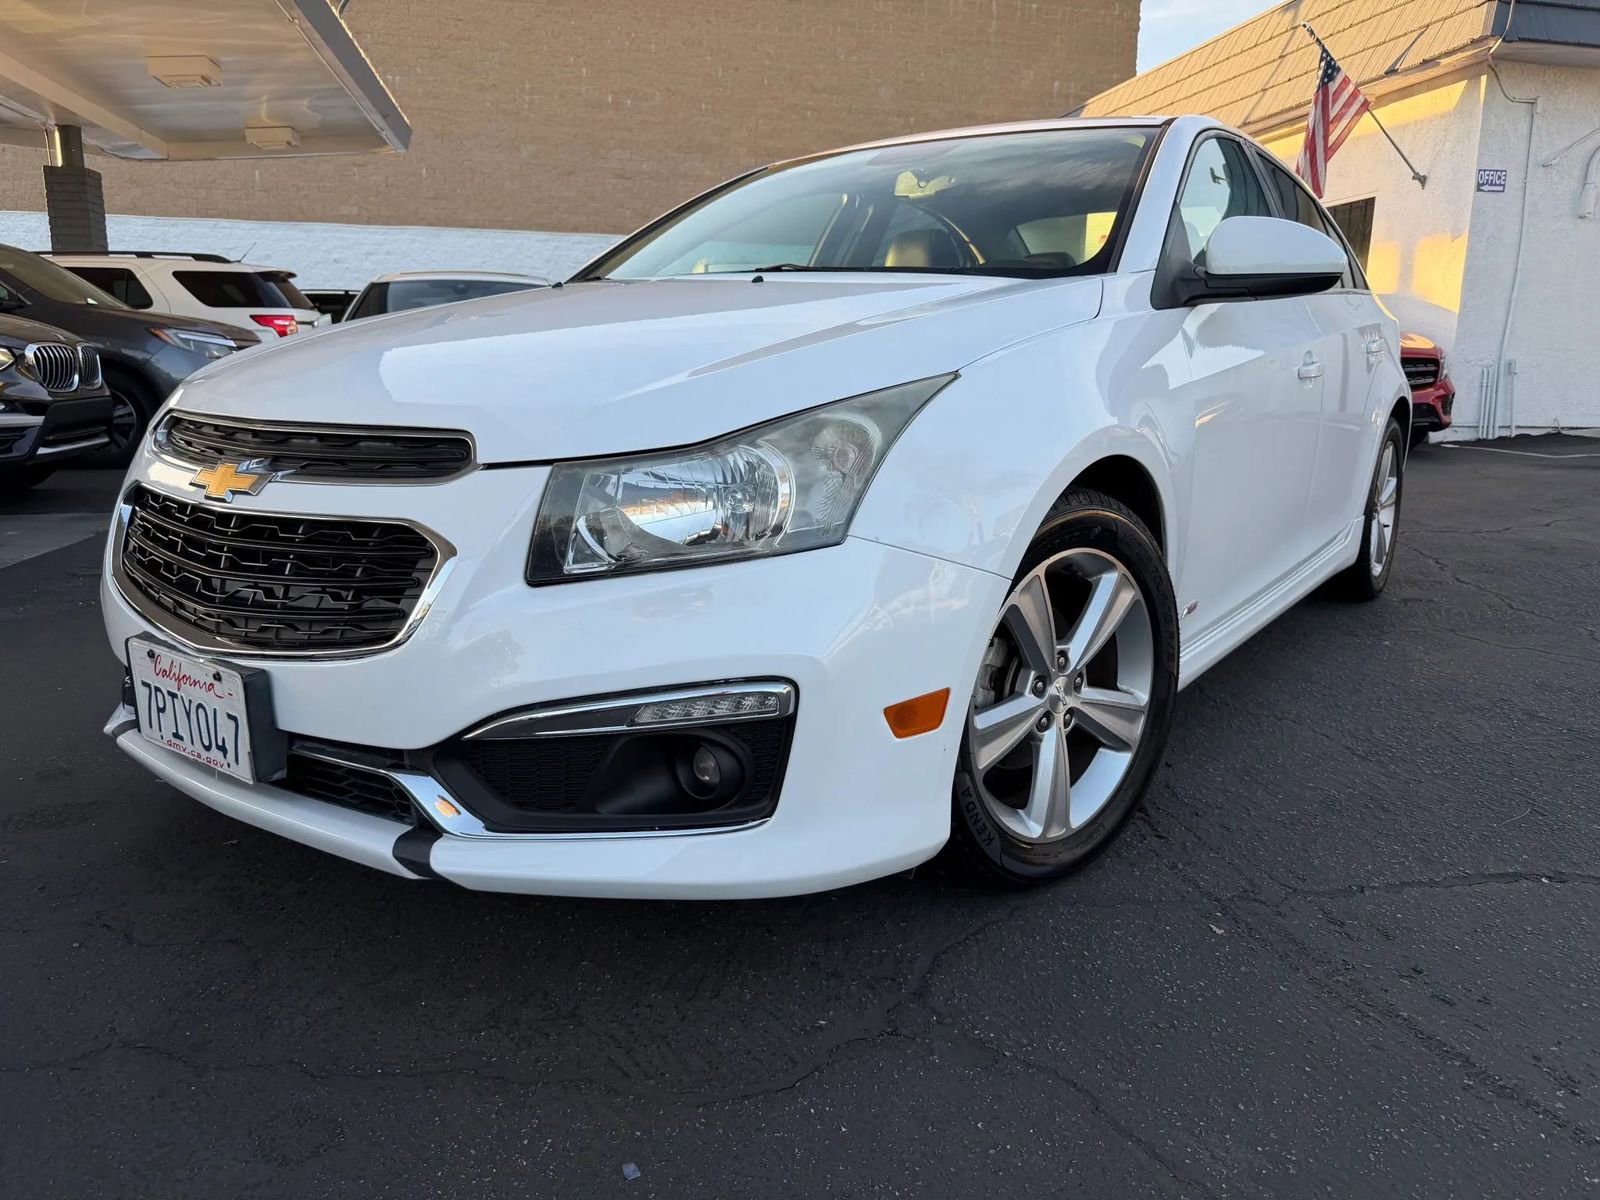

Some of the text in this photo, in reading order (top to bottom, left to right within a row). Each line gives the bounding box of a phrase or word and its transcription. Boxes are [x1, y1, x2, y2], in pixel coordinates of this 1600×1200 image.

[1478, 170, 1506, 184] OFFICE
[153, 654, 224, 698] California
[166, 739, 225, 769] dmv.ca.gov
[960, 785, 995, 847] KENDA
